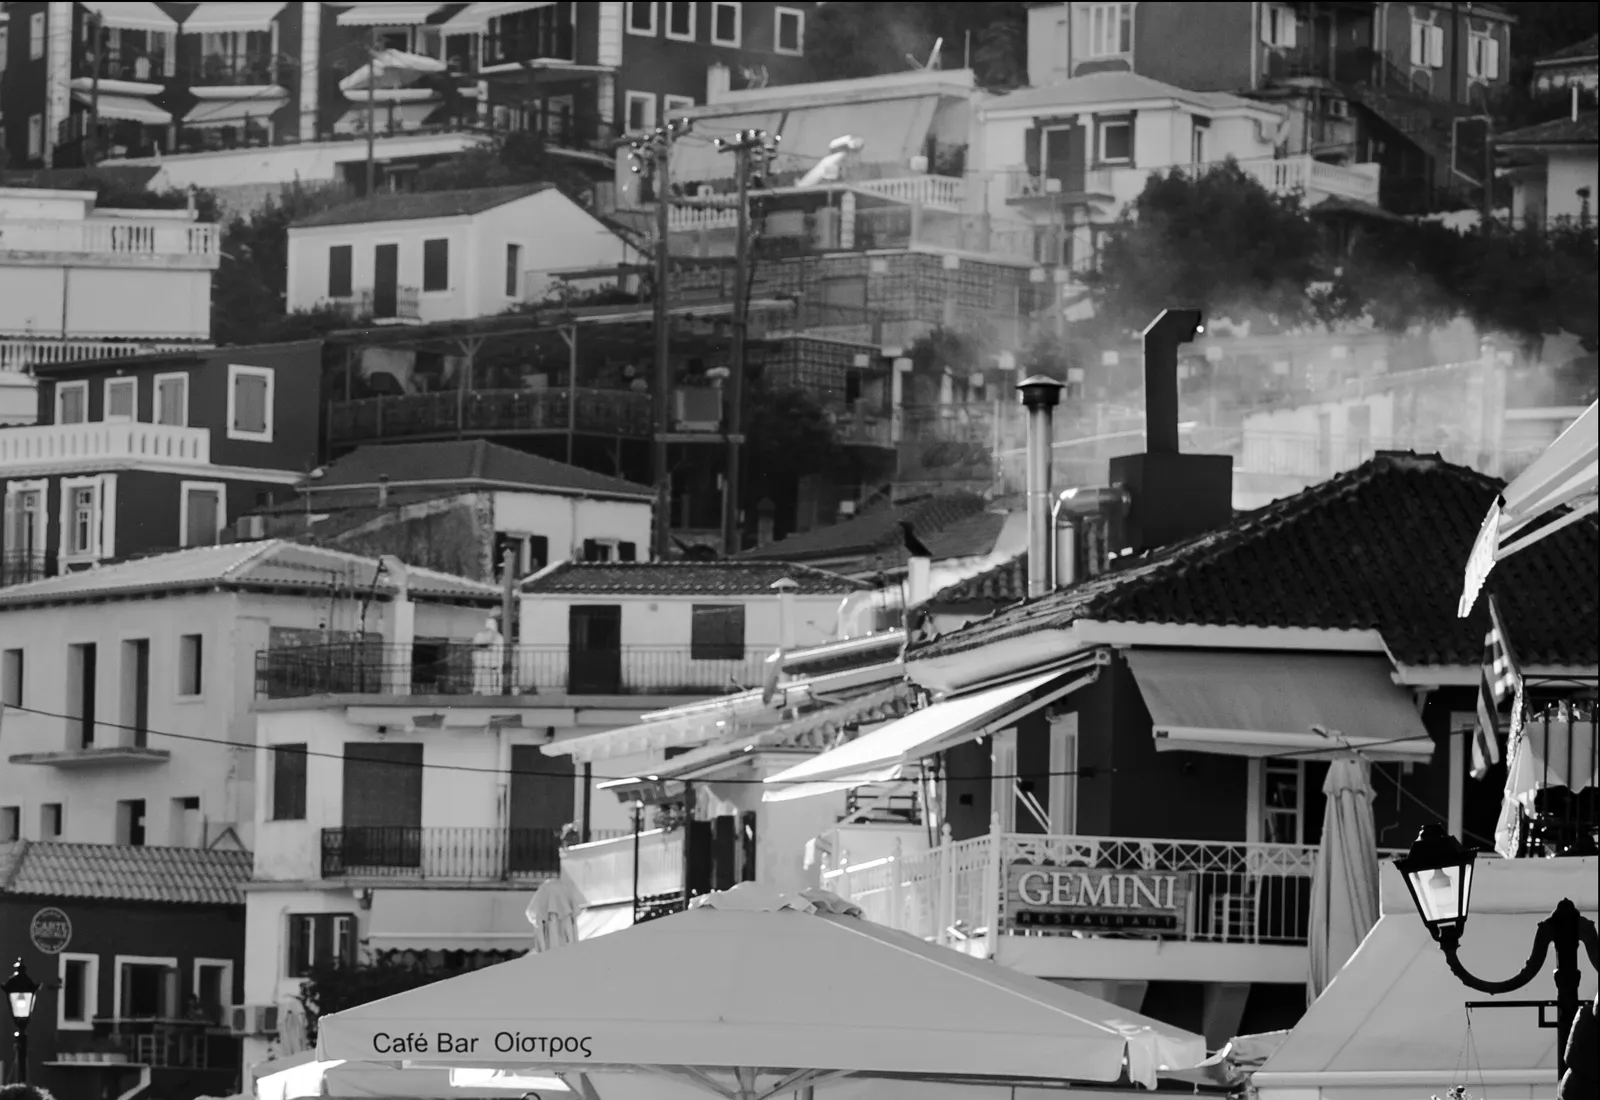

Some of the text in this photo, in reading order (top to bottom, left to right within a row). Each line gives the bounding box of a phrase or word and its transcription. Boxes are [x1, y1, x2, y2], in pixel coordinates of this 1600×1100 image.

[1018, 870, 1177, 909] GEMINI
[1022, 913, 1172, 927] RESTAURANT
[372, 1031, 593, 1058] Café Bar Οίστρος
